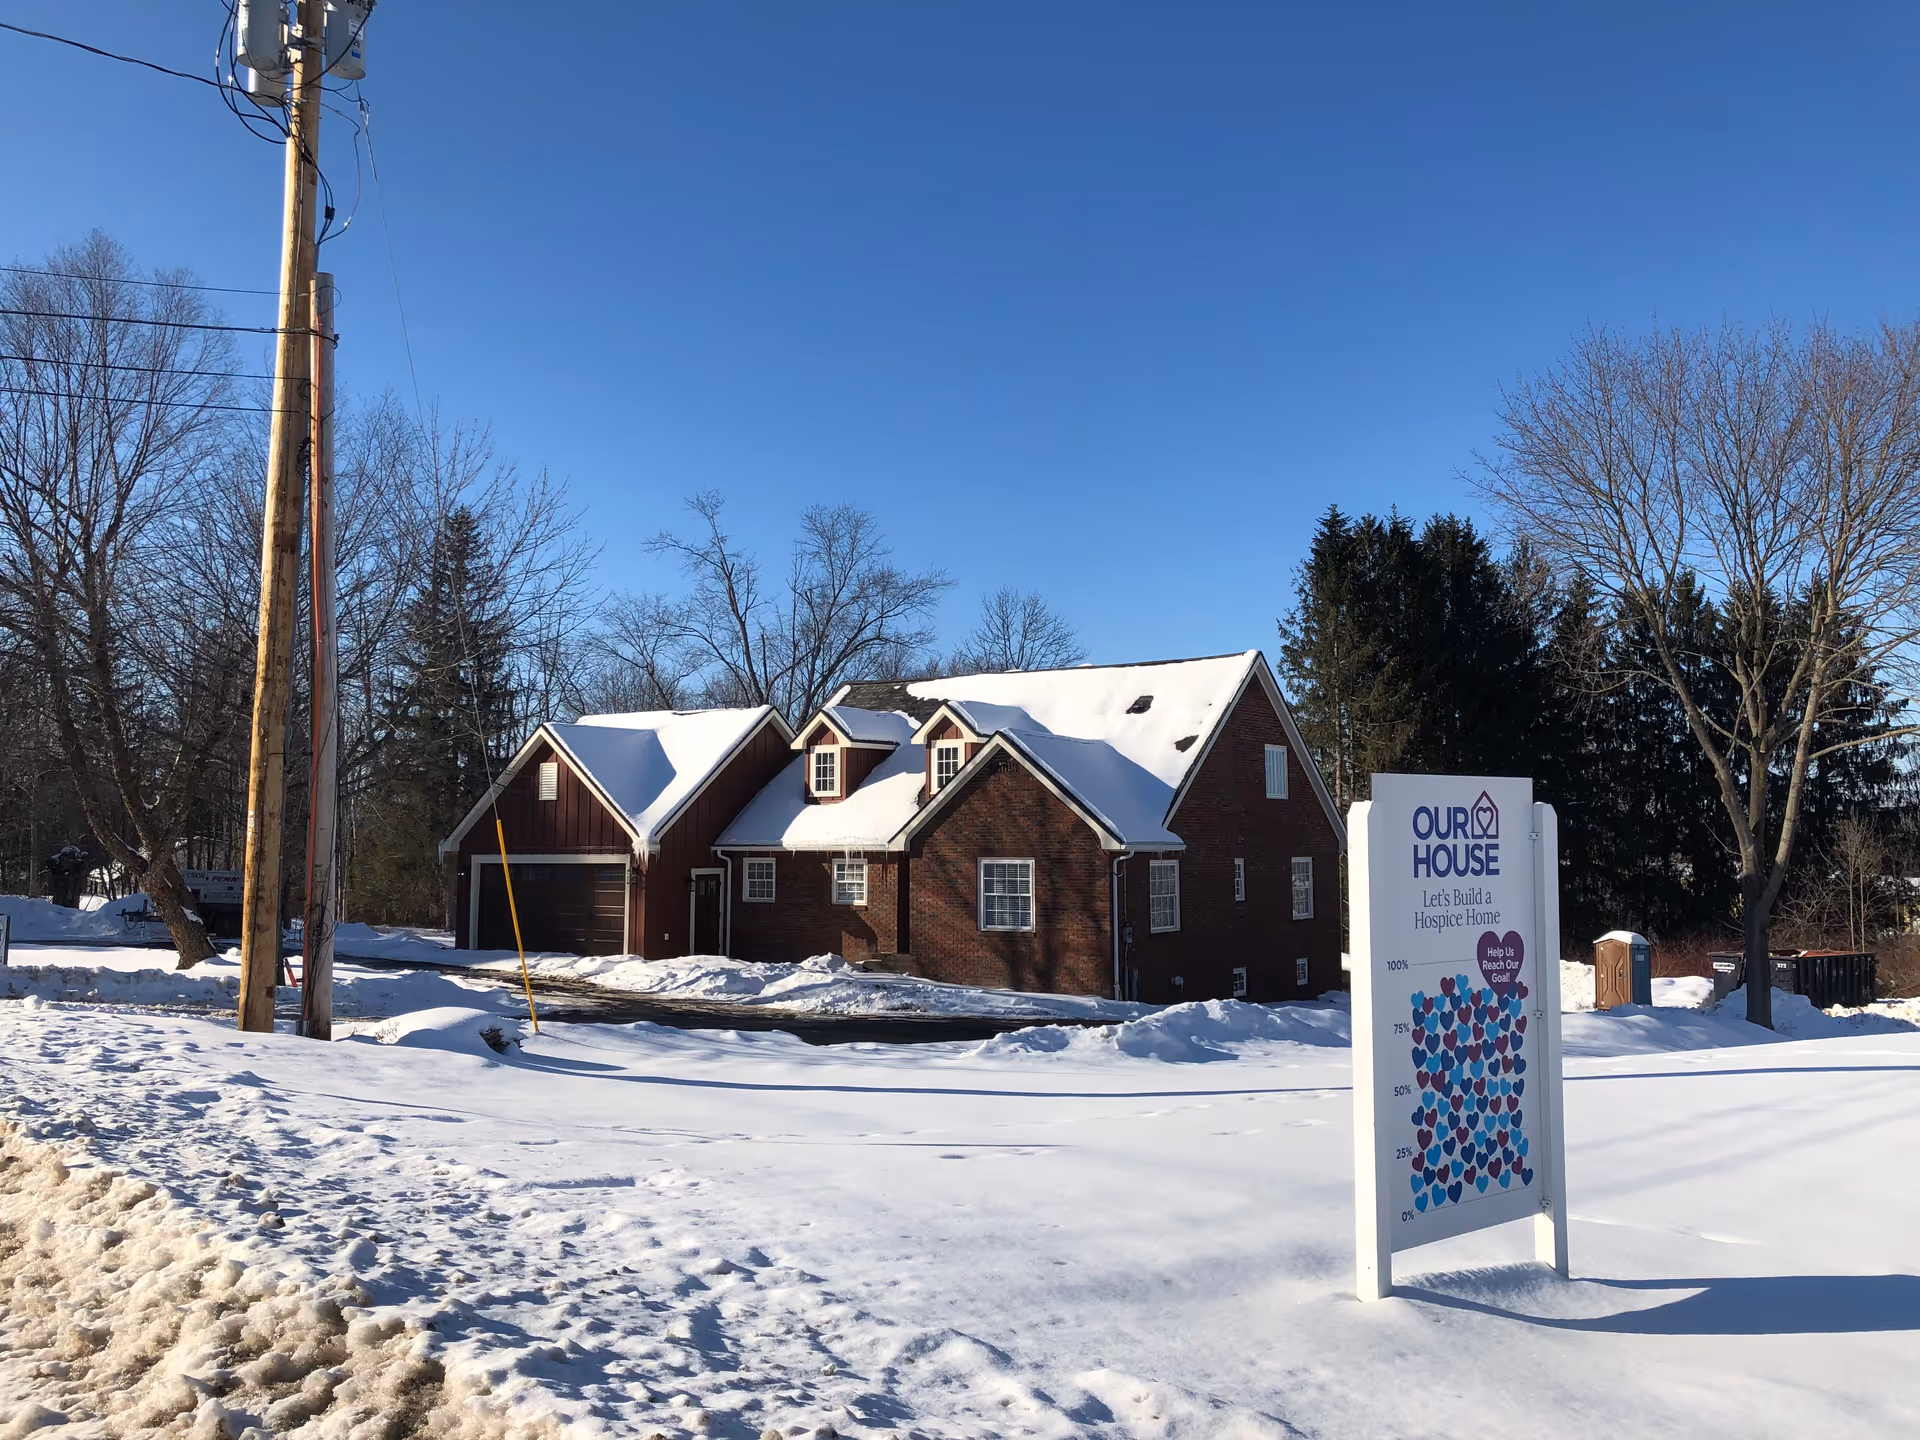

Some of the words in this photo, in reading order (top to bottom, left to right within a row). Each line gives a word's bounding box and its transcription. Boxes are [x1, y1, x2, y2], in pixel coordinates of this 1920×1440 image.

[1412, 805, 1469, 841] OUR
[1413, 843, 1500, 879] HOUSE
[1423, 889, 1450, 908] Let's
[1453, 887, 1483, 907] Build
[1485, 892, 1492, 905] a
[1415, 910, 1463, 933] Hospice
[1466, 908, 1501, 926] Home
[1487, 946, 1504, 958] Help
[1505, 946, 1515, 957] Us
[1387, 959, 1409, 971] 100%
[1482, 960, 1505, 971] Reach
[1506, 959, 1519, 970] Our
[1491, 973, 1511, 983] Goal!
[1394, 1023, 1410, 1035] 75%
[1394, 1086, 1411, 1097] 50%
[1396, 1147, 1413, 1160] 25%
[1401, 1210, 1415, 1222] 0%
